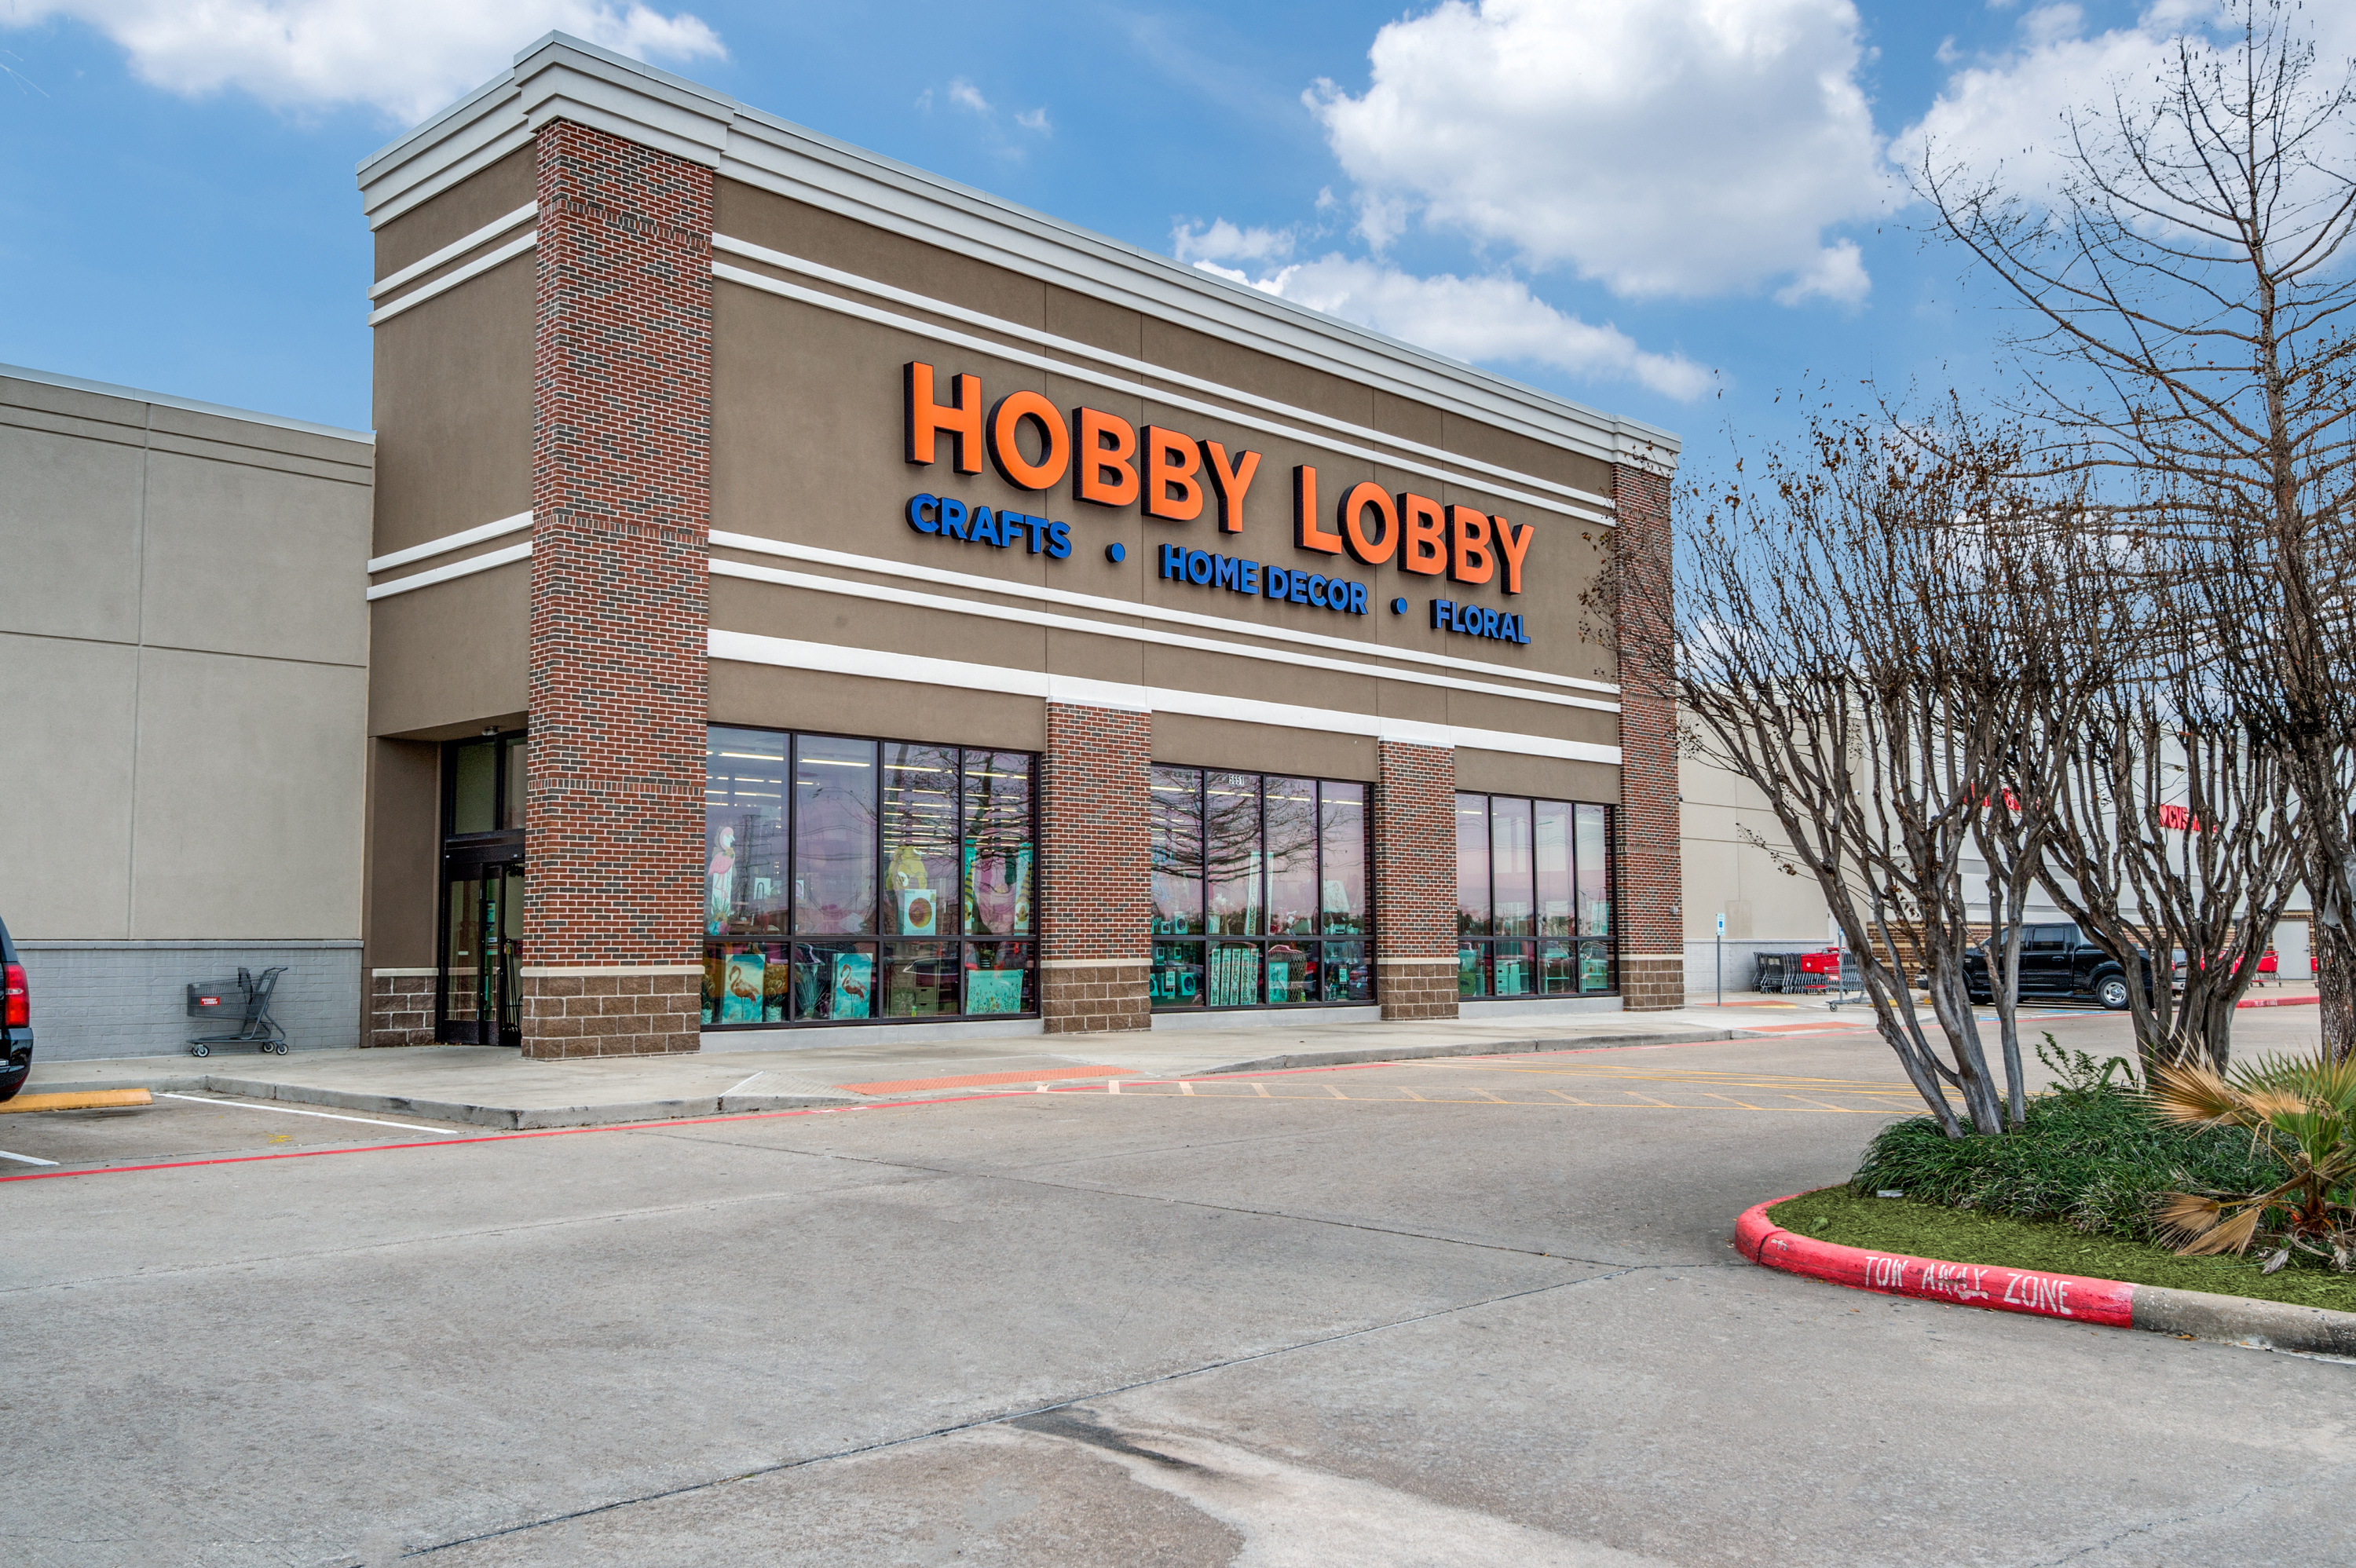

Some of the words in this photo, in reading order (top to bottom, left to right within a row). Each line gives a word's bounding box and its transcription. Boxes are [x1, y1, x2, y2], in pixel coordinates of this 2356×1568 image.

[904, 361, 1261, 534] HOBBY
[1293, 465, 1535, 595] LOBBY
[905, 493, 1071, 558] CRAFTS
[1158, 543, 1259, 594] HOME
[1262, 565, 1368, 615] DECOR
[1429, 599, 1531, 644] FLORAL
[1230, 775, 1243, 784] 5651
[2168, 805, 2189, 830] CVS
[1249, 872, 1257, 929] WELCOME
[1865, 1256, 1908, 1287] TOW
[1922, 1263, 1988, 1296] AWAY
[2003, 1273, 2072, 1315] ZONE
